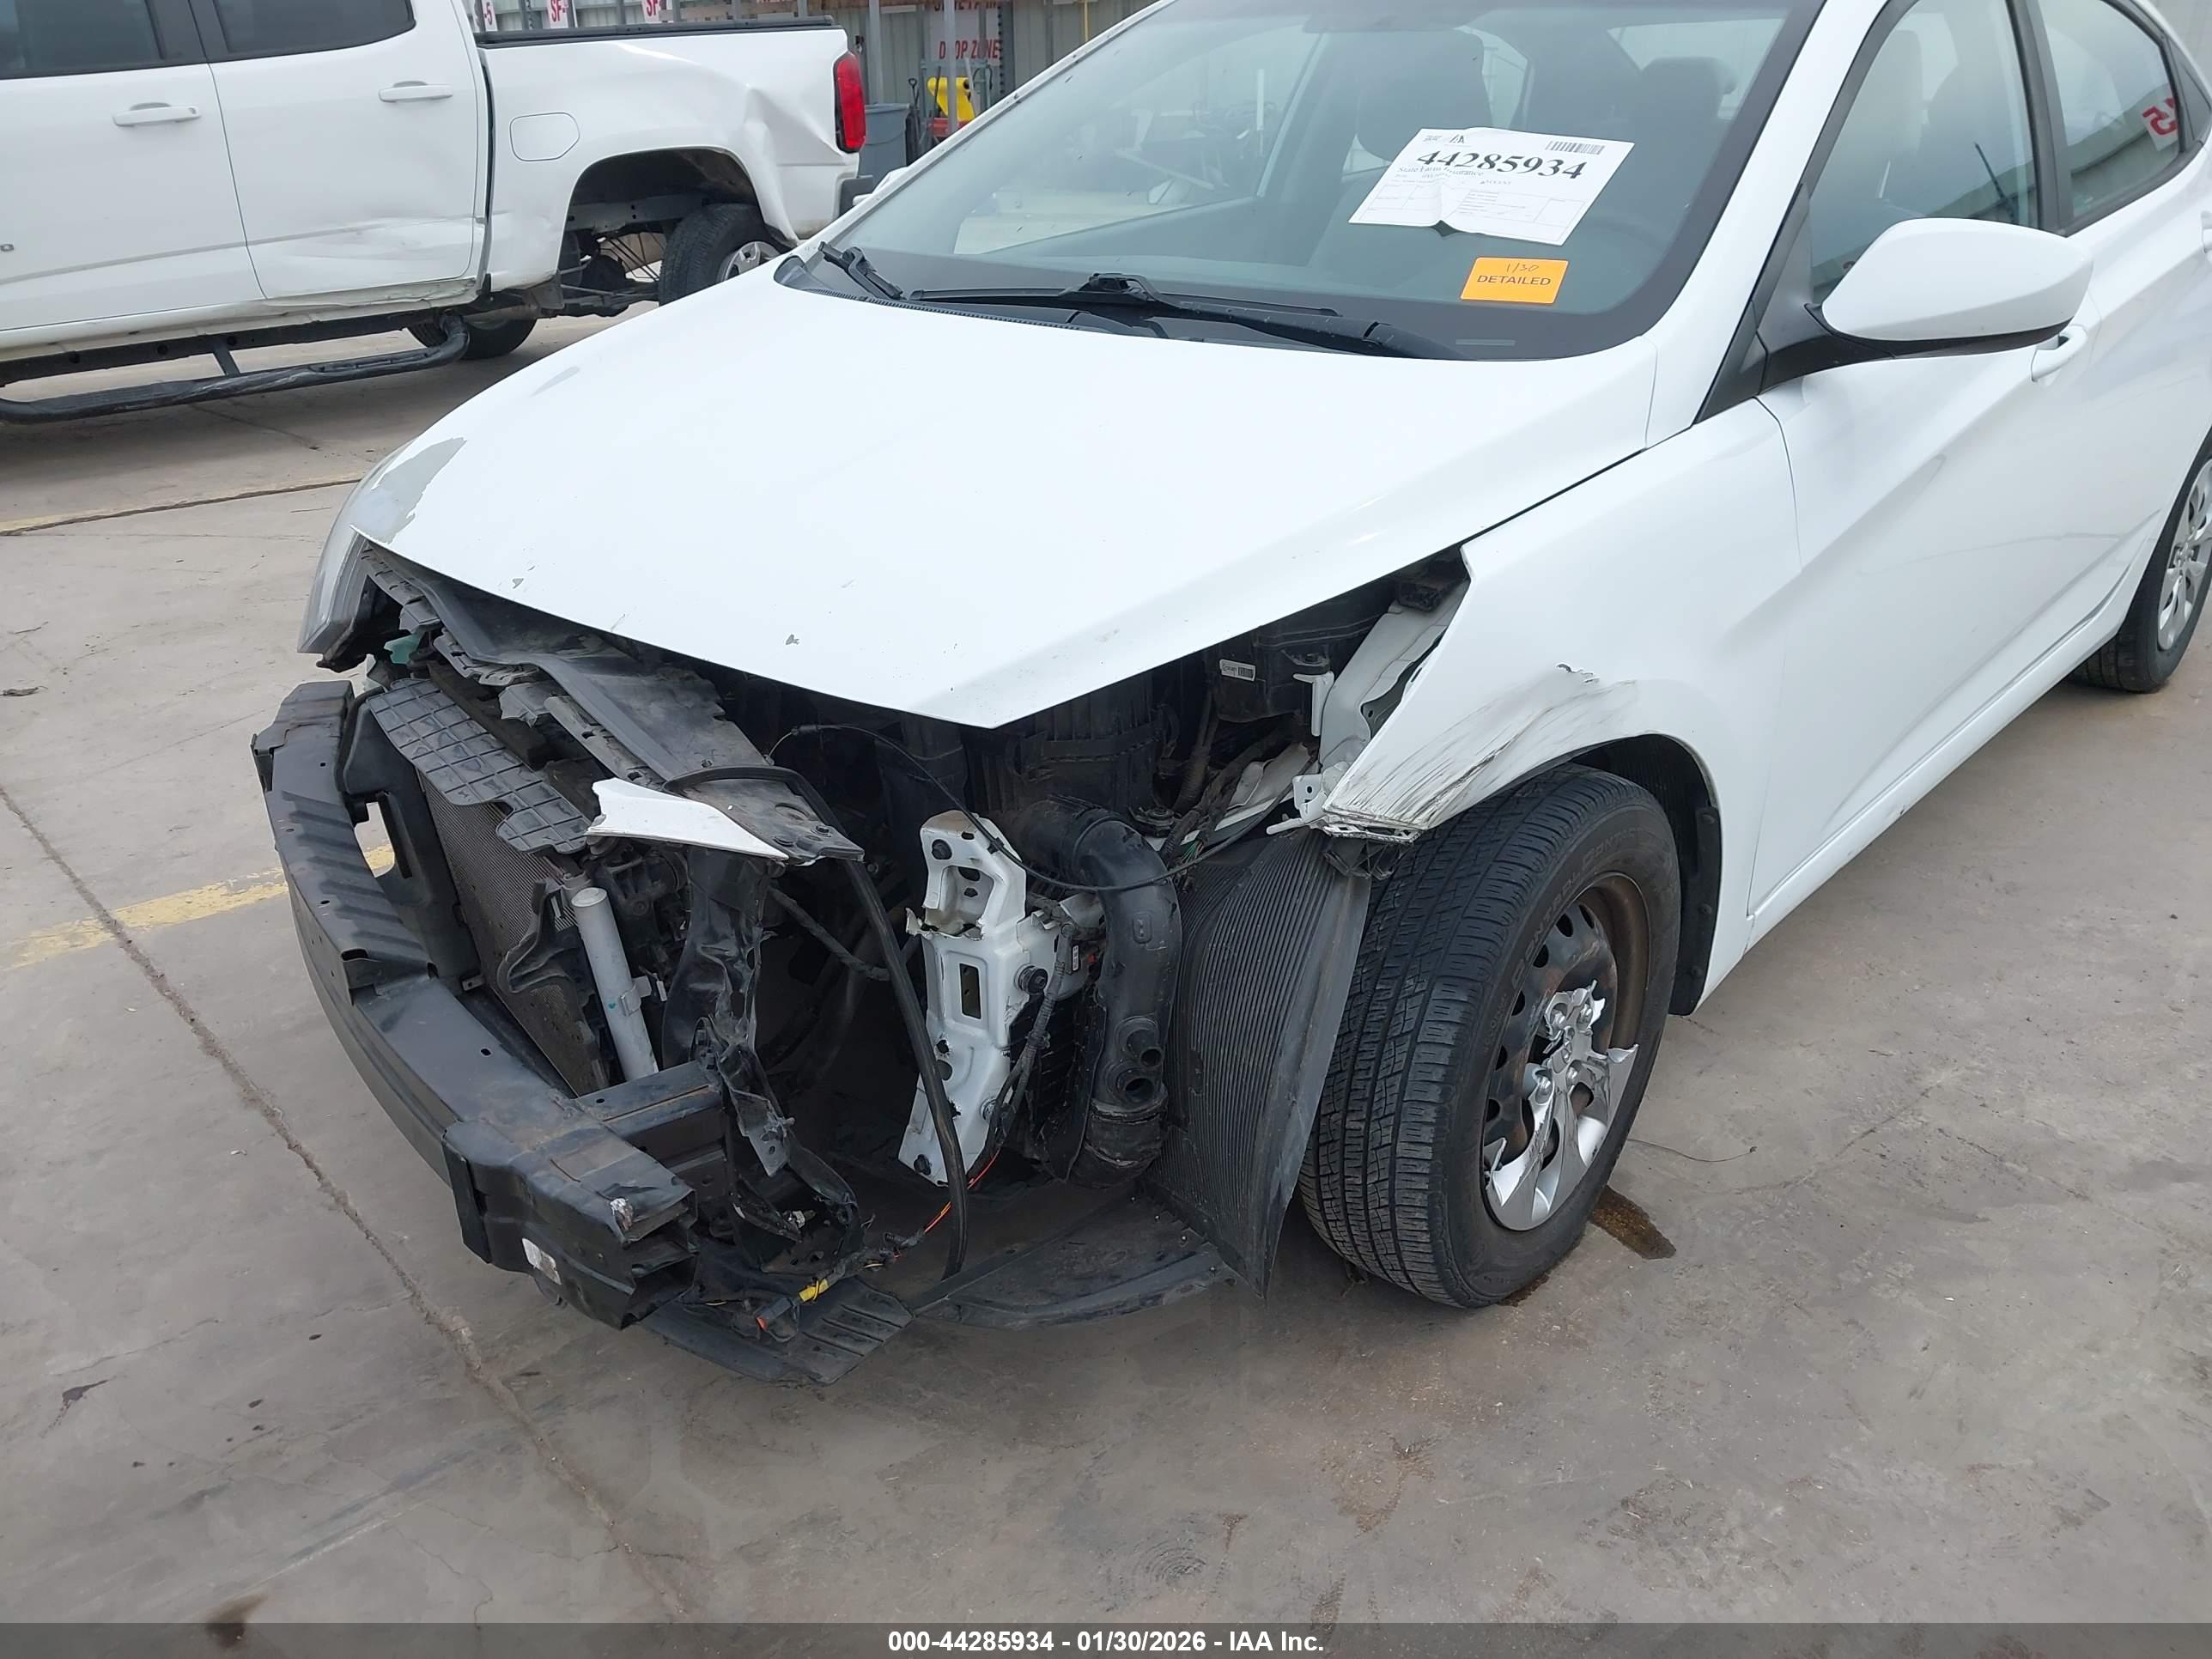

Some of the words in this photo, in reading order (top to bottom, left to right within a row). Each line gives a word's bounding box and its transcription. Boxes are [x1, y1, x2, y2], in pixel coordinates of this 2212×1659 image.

[1417, 150, 1588, 179] 44285934
[1505, 262, 1540, 274] 1/30
[1476, 274, 1552, 286] DETAILED
